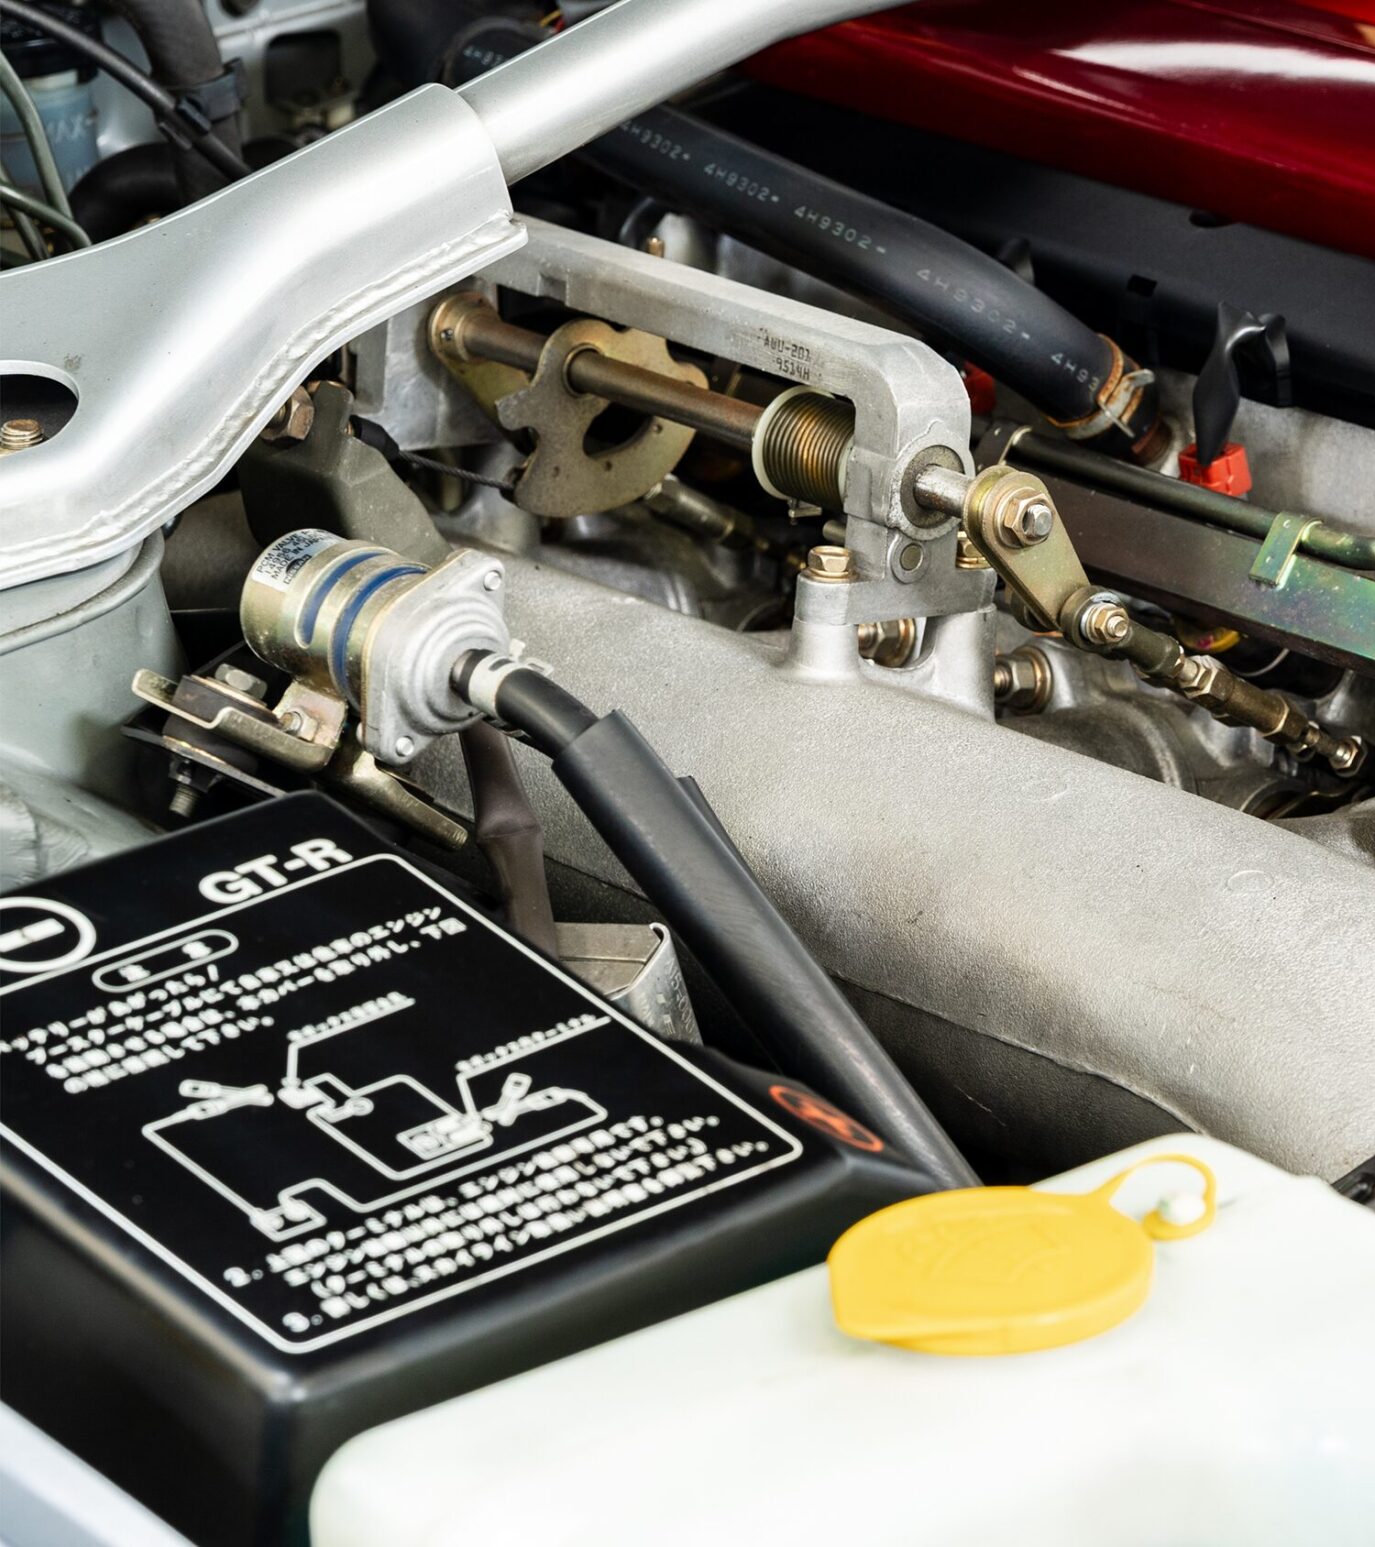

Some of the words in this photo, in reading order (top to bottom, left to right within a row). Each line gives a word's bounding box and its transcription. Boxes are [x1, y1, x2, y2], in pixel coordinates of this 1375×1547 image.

[257, 551, 274, 574] PCM
[271, 553, 293, 580] MADE
[198, 838, 353, 904] GT-R
